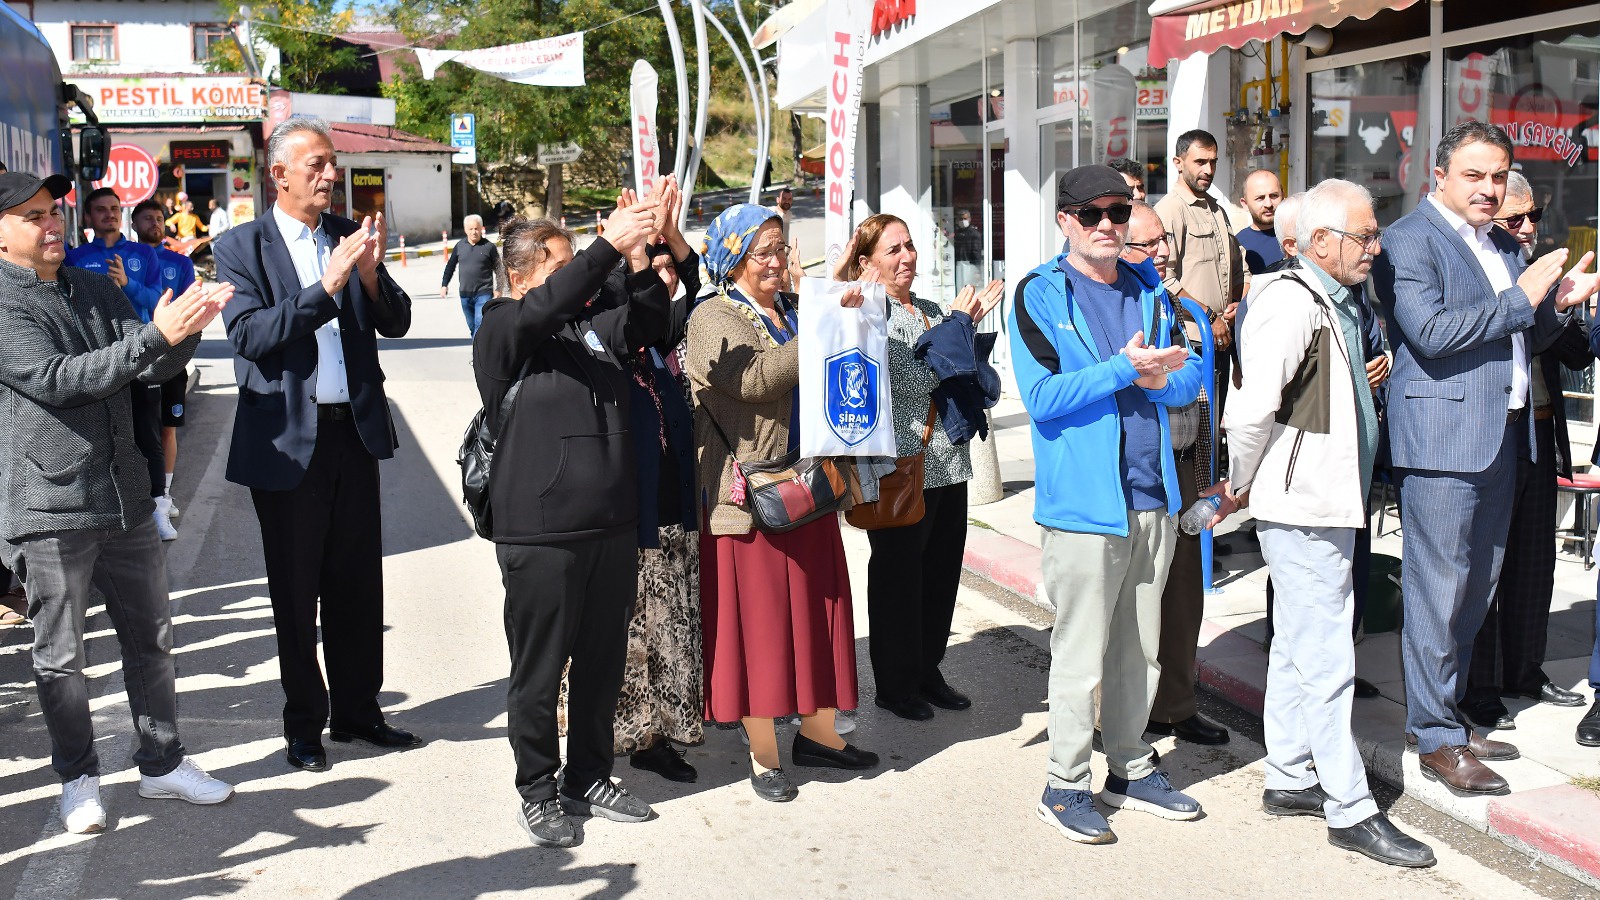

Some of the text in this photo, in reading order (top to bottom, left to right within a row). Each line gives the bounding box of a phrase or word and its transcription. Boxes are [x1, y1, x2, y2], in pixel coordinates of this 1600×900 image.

[1184, 0, 1304, 41] MEYDAN
[100, 83, 260, 106] PESTİL KÖME
[829, 31, 851, 217] BOSCH
[173, 144, 225, 159] PESTİL
[1523, 121, 1584, 168] ÇAYEVİ
[103, 160, 150, 189] DUR
[353, 174, 384, 186] ÖZTÜRK
[838, 411, 869, 425] ŞİRAN
